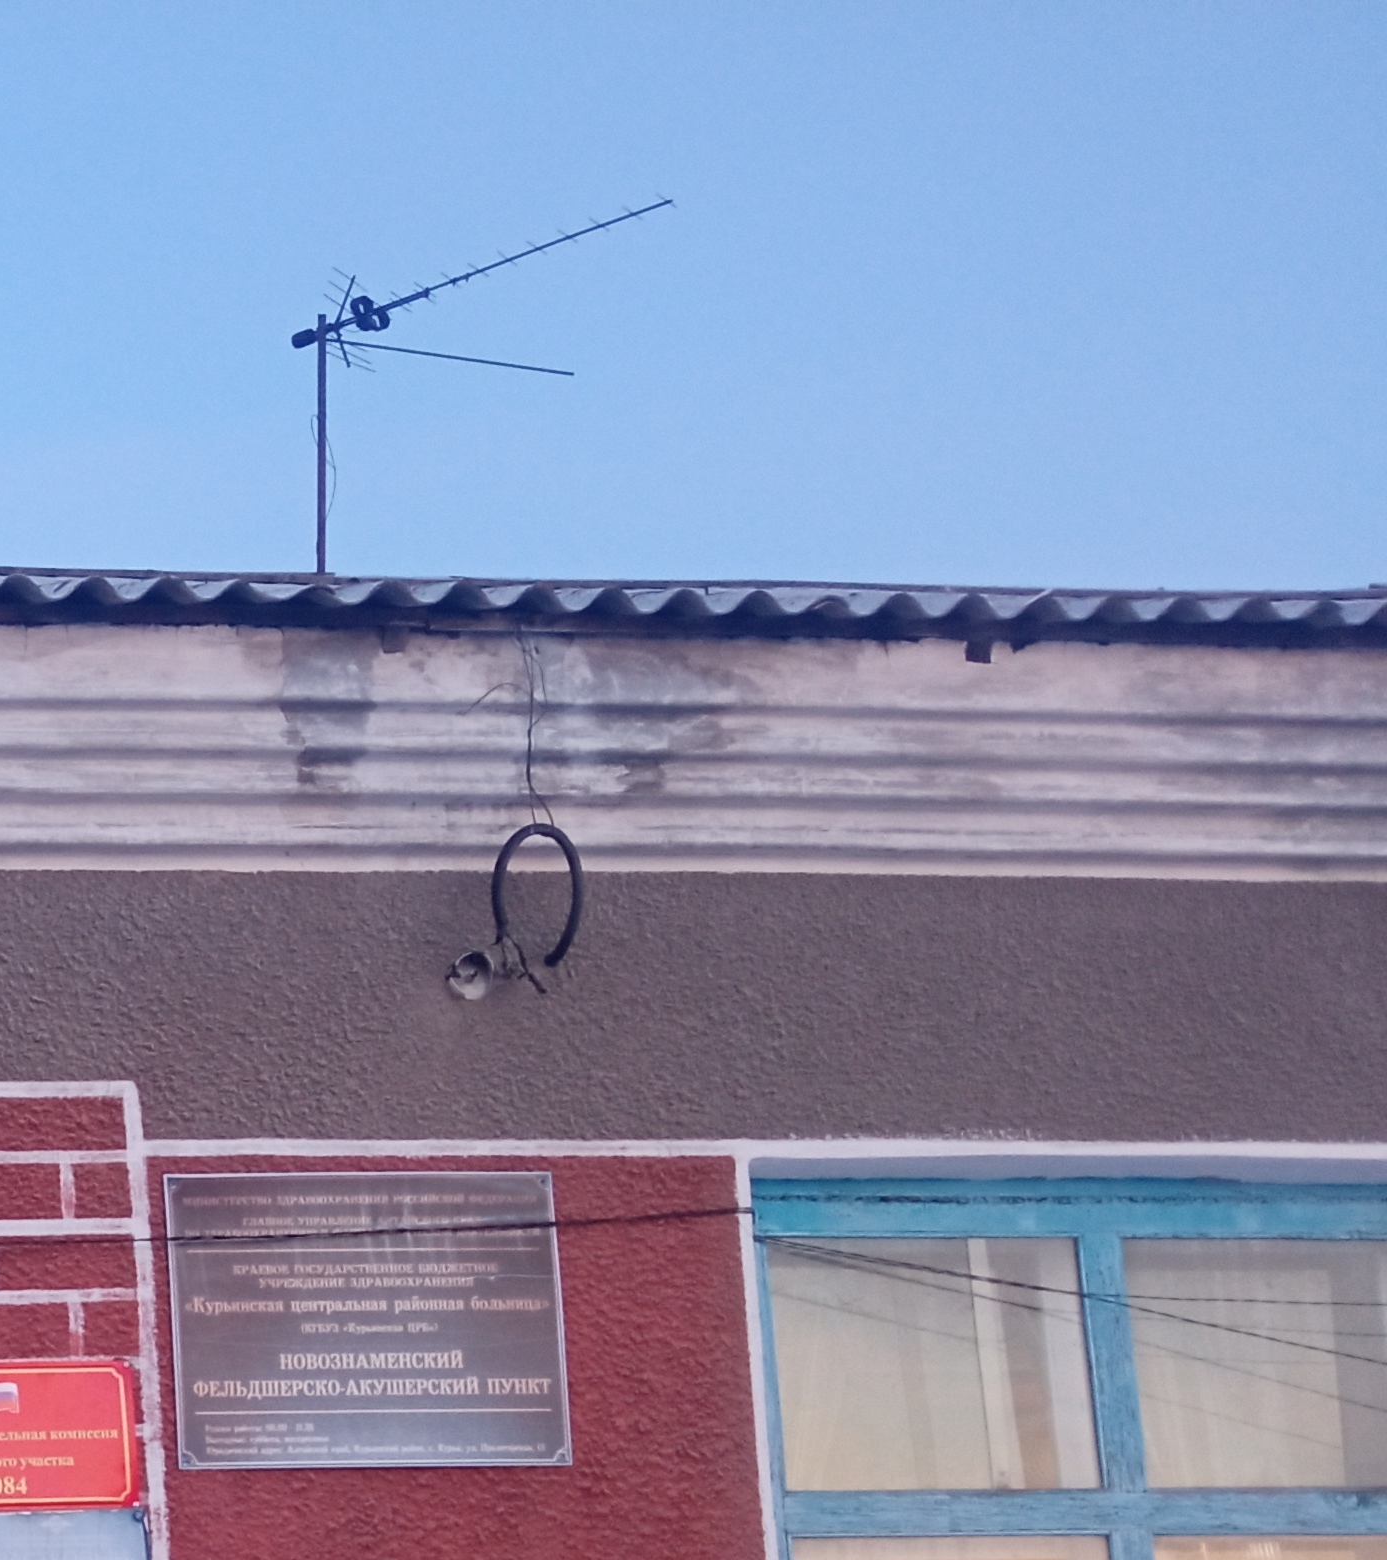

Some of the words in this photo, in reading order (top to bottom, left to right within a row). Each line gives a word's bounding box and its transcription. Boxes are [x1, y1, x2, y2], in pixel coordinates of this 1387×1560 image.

[233, 1264, 290, 1276] КРАЕВОЕ
[294, 1263, 414, 1277] ГОСУДАРСТВЕННОЕ
[259, 1277, 346, 1289] УЧРЕЖДЕНИЕ
[349, 1276, 475, 1288] ЗДРАВООХРАНЕНИЯ
[291, 1298, 388, 1316] центральная
[394, 1296, 464, 1315] районная
[279, 1349, 464, 1371] НОВОЗНАМЕНСКИЙ
[192, 1376, 480, 1400] ФЕЛЬДШЕРСКО-АКУШЕРСКИЙ
[487, 1378, 551, 1395] ПУНКТ
[50, 1427, 119, 1441] комиссия
[20, 1456, 75, 1470] участка
